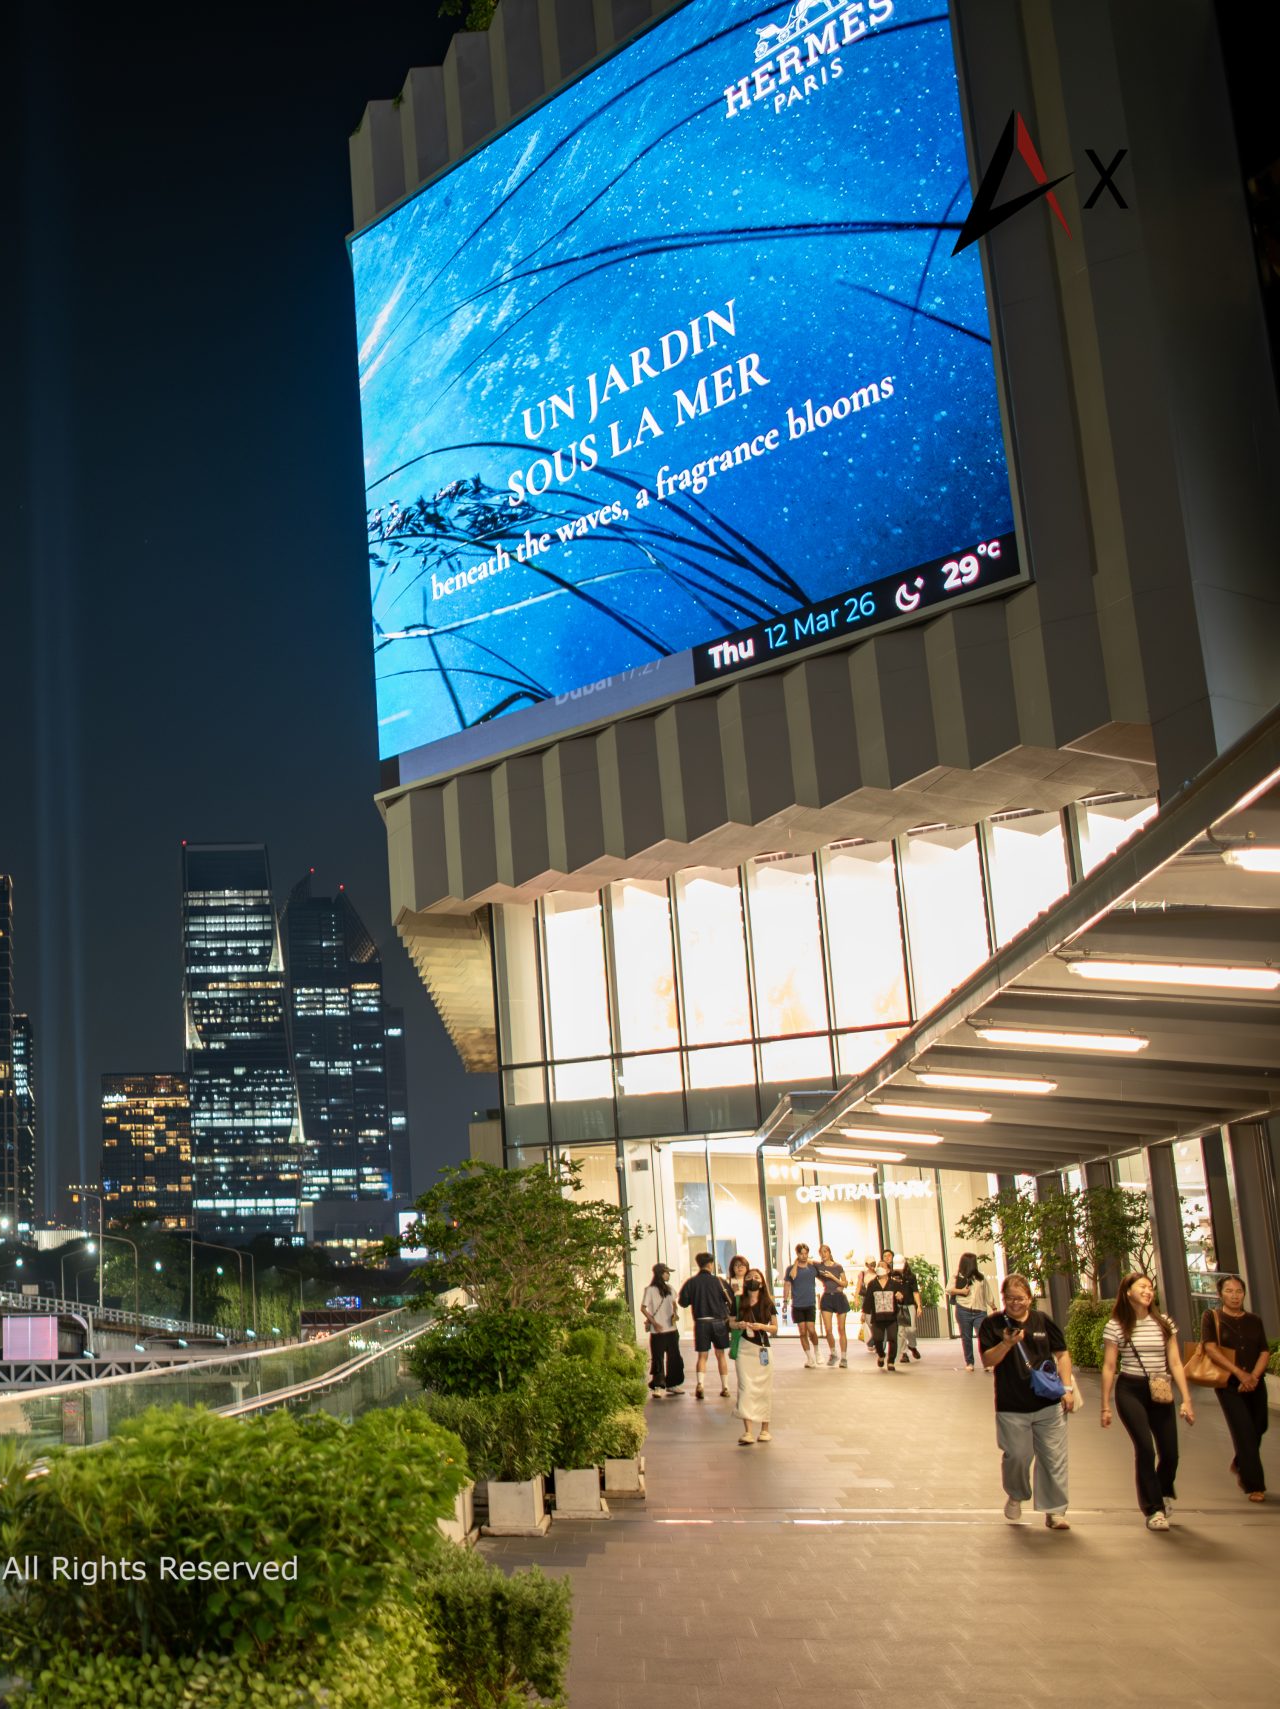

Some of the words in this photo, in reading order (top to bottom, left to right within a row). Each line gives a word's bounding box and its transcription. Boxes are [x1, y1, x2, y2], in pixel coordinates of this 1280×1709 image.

[774, 57, 845, 114] PARIS
[521, 385, 575, 442] UN
[586, 298, 737, 423] JARDIN
[507, 434, 599, 507] SOUS
[608, 411, 664, 459] LA
[672, 352, 771, 427] MER
[430, 547, 510, 601] beneath
[516, 528, 552, 562] the
[556, 499, 630, 543] waves,
[636, 489, 649, 509] a
[655, 427, 780, 501] fragrance
[786, 375, 895, 441] blooms
[708, 638, 754, 668] Thu
[764, 623, 788, 650] 12
[794, 609, 839, 640] Mar
[844, 591, 876, 623] 26
[796, 1183, 881, 1203] CENTRAL
